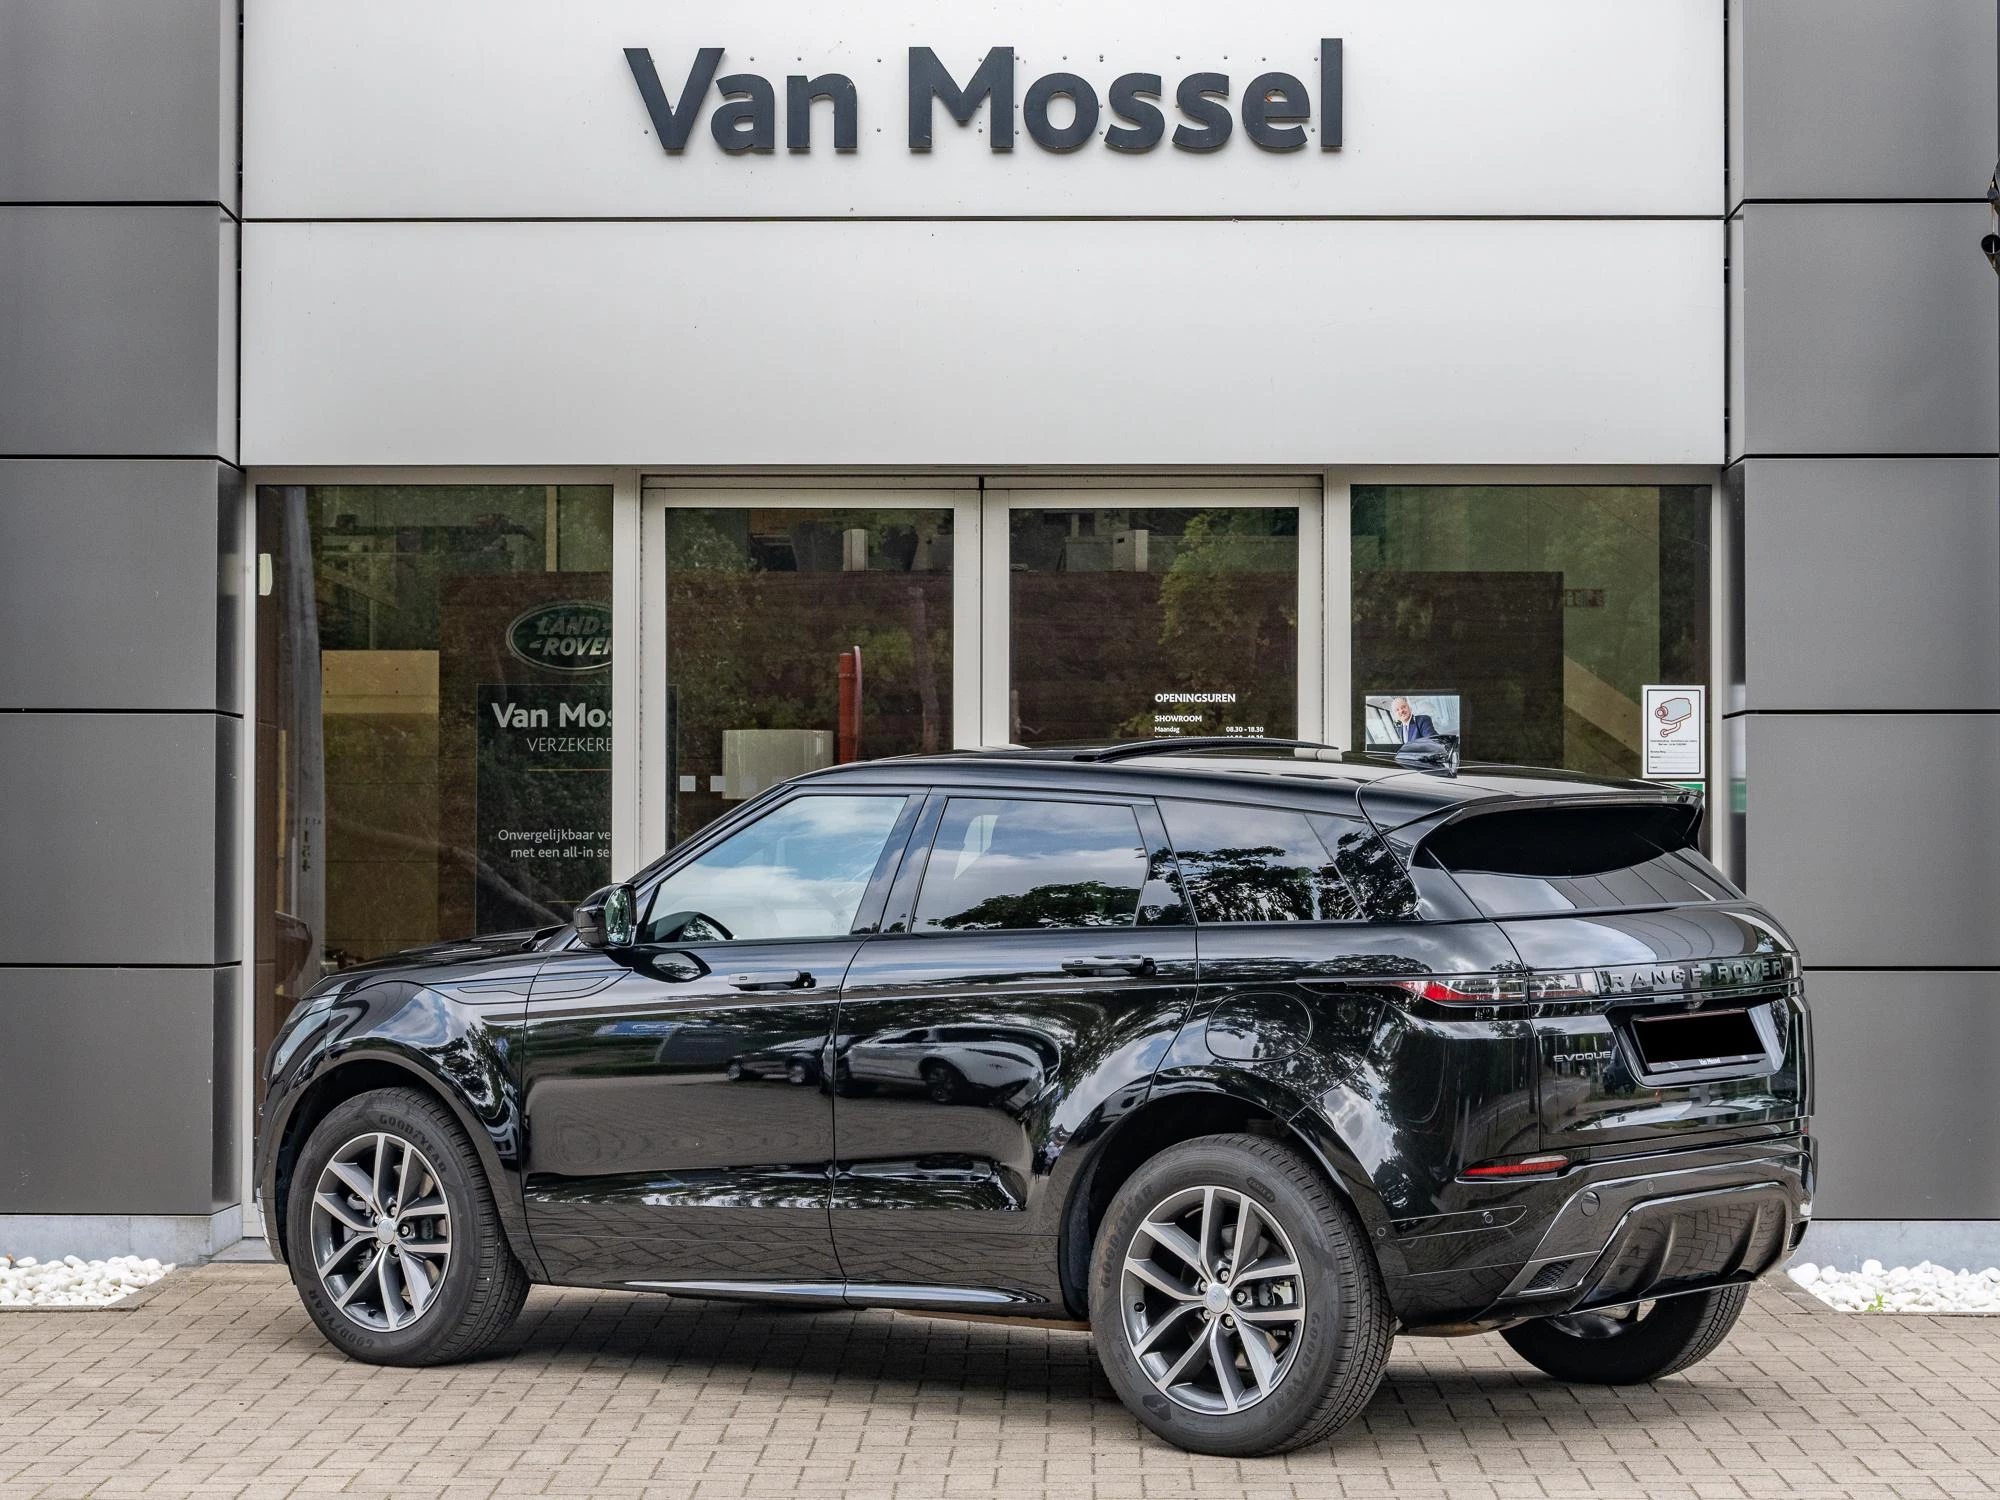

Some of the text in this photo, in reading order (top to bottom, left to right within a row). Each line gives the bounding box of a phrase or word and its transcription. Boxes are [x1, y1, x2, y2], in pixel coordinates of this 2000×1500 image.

[623, 37, 1343, 150] Van Mossel
[536, 616, 601, 636] LAND
[1154, 693, 1236, 703] OPENINGSUREN
[491, 702, 549, 729] Van
[1154, 715, 1203, 723] SHOWROOM
[1154, 726, 1181, 734] Maandag
[498, 828, 595, 844] Onvergelijkbaar
[510, 848, 535, 858] met
[538, 848, 560, 858] een
[562, 846, 594, 858] all-in
[1609, 960, 1784, 988] RANGE ROVER
[1553, 1050, 1612, 1063] EVOQUE
[379, 1114, 447, 1173] GOODYEAR
[307, 1289, 375, 1350] GOODYEAR
